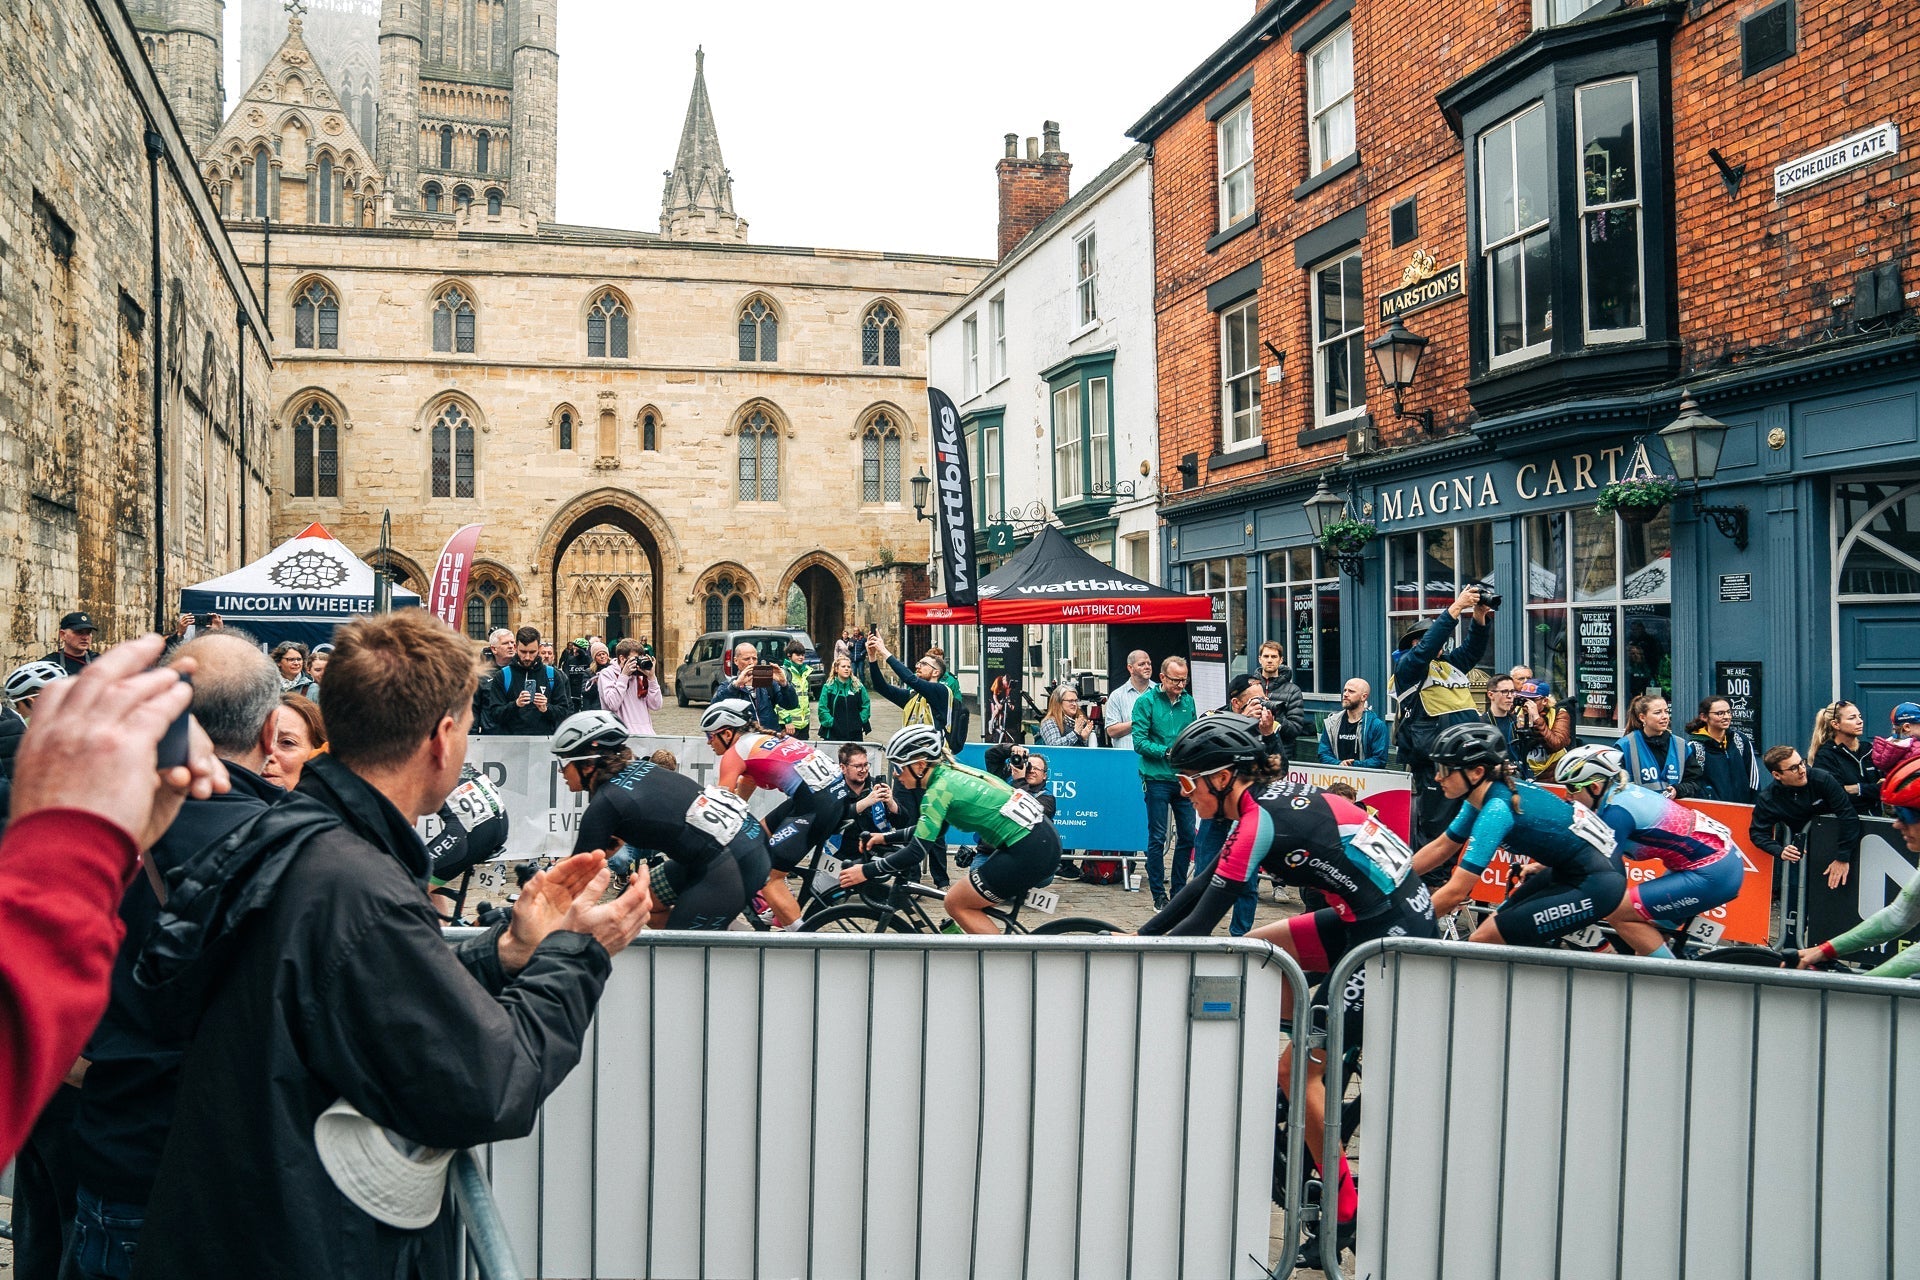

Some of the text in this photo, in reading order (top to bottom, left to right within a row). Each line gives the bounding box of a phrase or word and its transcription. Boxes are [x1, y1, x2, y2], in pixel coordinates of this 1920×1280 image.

[1779, 149, 1847, 187] EXCHEQUER
[1382, 272, 1459, 317] MARSTON'S
[1382, 443, 1656, 522] MAGNA CARTA
[937, 405, 969, 592] wattbike
[997, 531, 1006, 546] 2
[1017, 579, 1150, 595] wattbike
[215, 595, 291, 611] LINCOLN
[1062, 604, 1141, 616] WATTBIKE.COM
[1294, 601, 1313, 611] ROOM
[1582, 613, 1610, 621] WEEKLY
[1580, 622, 1612, 636] QUIZZES
[1191, 635, 1222, 644] MICHAELGATE
[1727, 678, 1750, 696] DOG
[1586, 695, 1607, 704] QUIZ
[1641, 766, 1658, 780] 30
[1046, 780, 1077, 799] ES
[1312, 773, 1366, 791] LINCOLN
[459, 791, 485, 819] 95
[1053, 818, 1087, 826] TRAINING
[1371, 832, 1408, 872] 21
[823, 859, 835, 873] 16
[479, 872, 494, 887] 95
[1309, 858, 1358, 892] Orientation
[1031, 893, 1051, 909] 121
[1533, 898, 1593, 926] RIBBLE
[1537, 909, 1594, 935] COLLECTIVE
[1696, 922, 1714, 938] 53
[1570, 929, 1596, 944] 41
